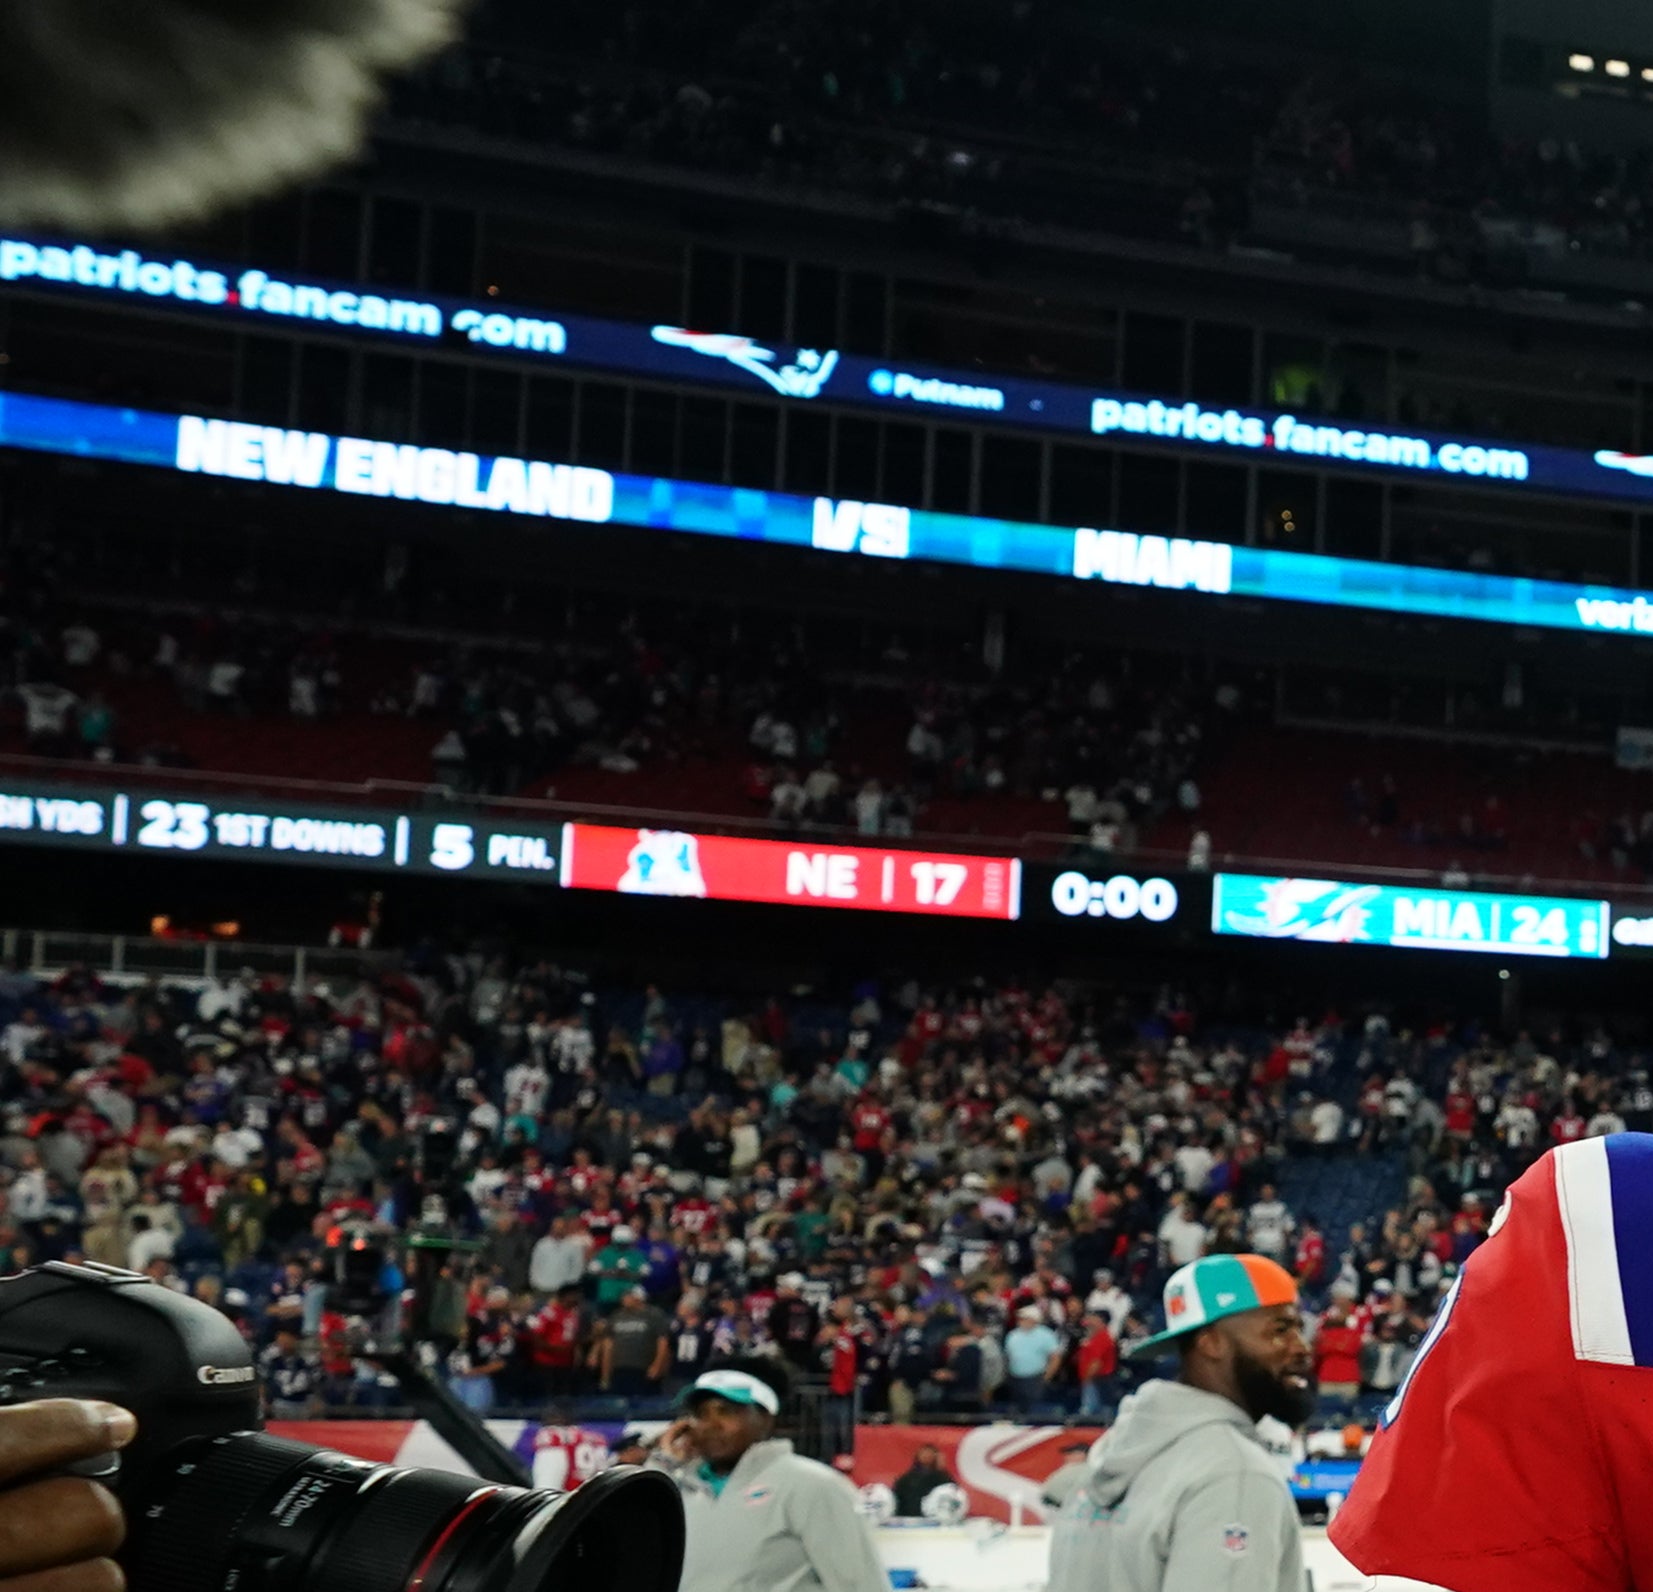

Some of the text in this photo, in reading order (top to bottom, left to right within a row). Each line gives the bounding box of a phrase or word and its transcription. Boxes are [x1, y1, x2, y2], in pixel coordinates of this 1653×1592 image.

[177, 416, 613, 522] NEW ENGLAND
[812, 497, 909, 557] VS
[1073, 528, 1232, 593] MIAMI
[138, 801, 209, 850] 23
[271, 817, 385, 857] DOWNS
[430, 824, 473, 870] 5
[488, 834, 555, 870] PEN.
[785, 851, 860, 899] NE
[910, 861, 968, 906] 17
[1051, 872, 1177, 921] 0:00
[1391, 898, 1568, 947] MIA 24
